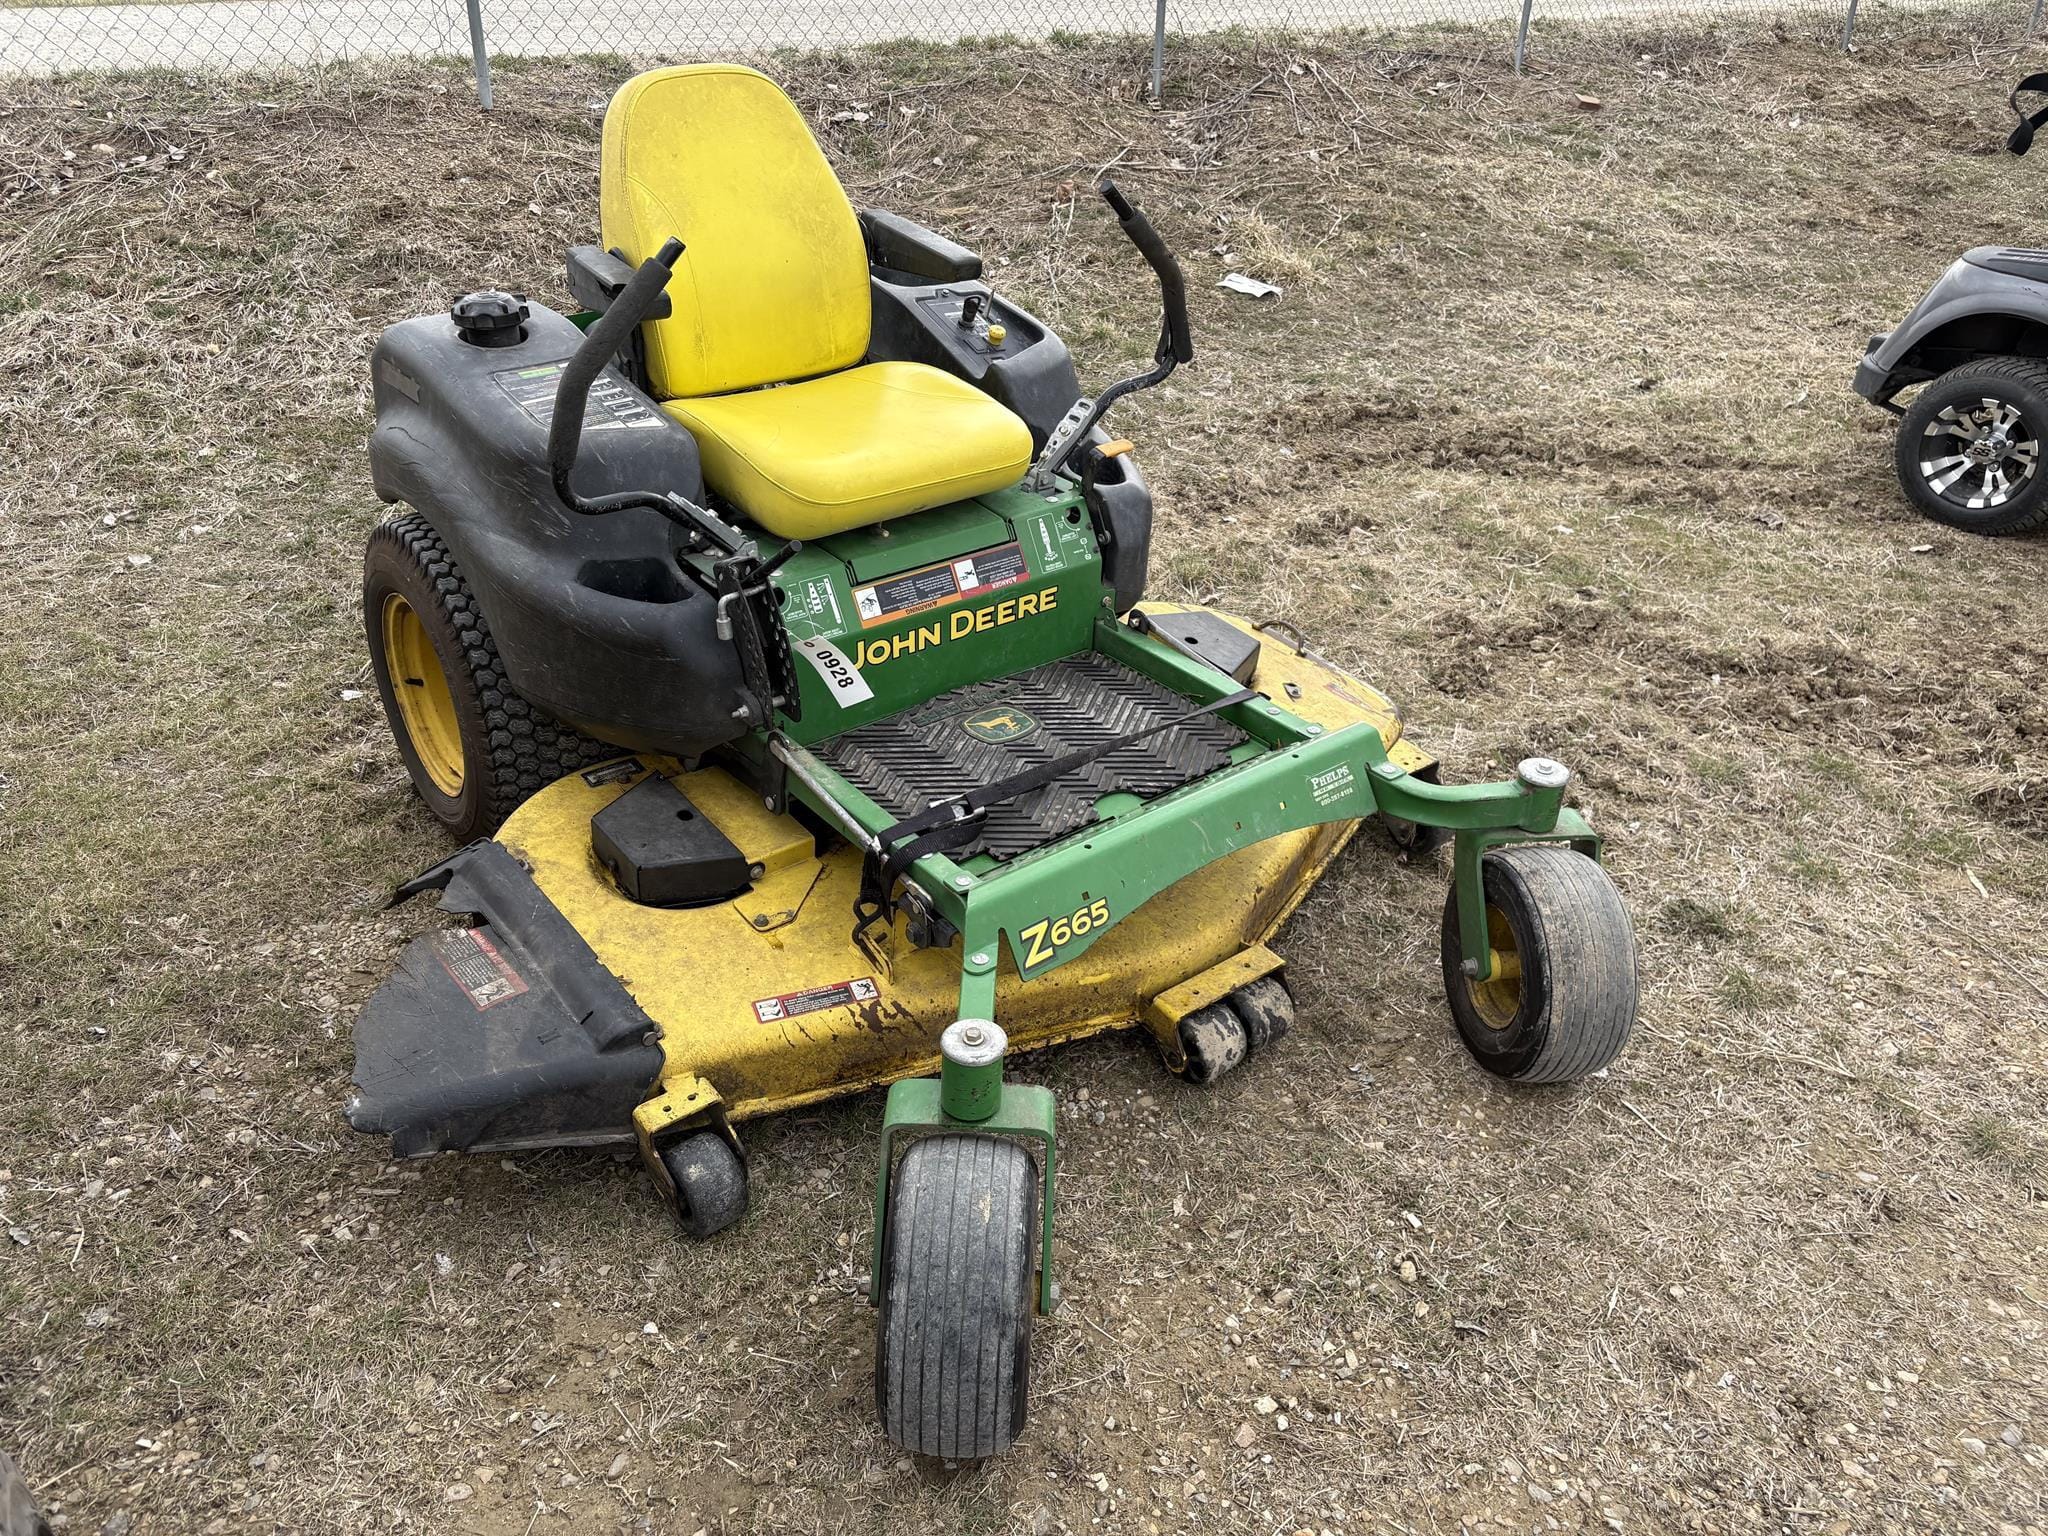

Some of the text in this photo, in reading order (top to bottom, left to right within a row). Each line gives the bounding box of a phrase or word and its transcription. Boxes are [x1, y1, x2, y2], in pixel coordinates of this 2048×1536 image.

[905, 601, 934, 615] WARNING
[854, 622, 942, 671] JOHN
[950, 586, 1059, 641] DEERE
[816, 650, 855, 688] 0928
[1311, 765, 1350, 790] PHELPS
[1019, 896, 1110, 972] Z665
[802, 985, 833, 996] DANGER
